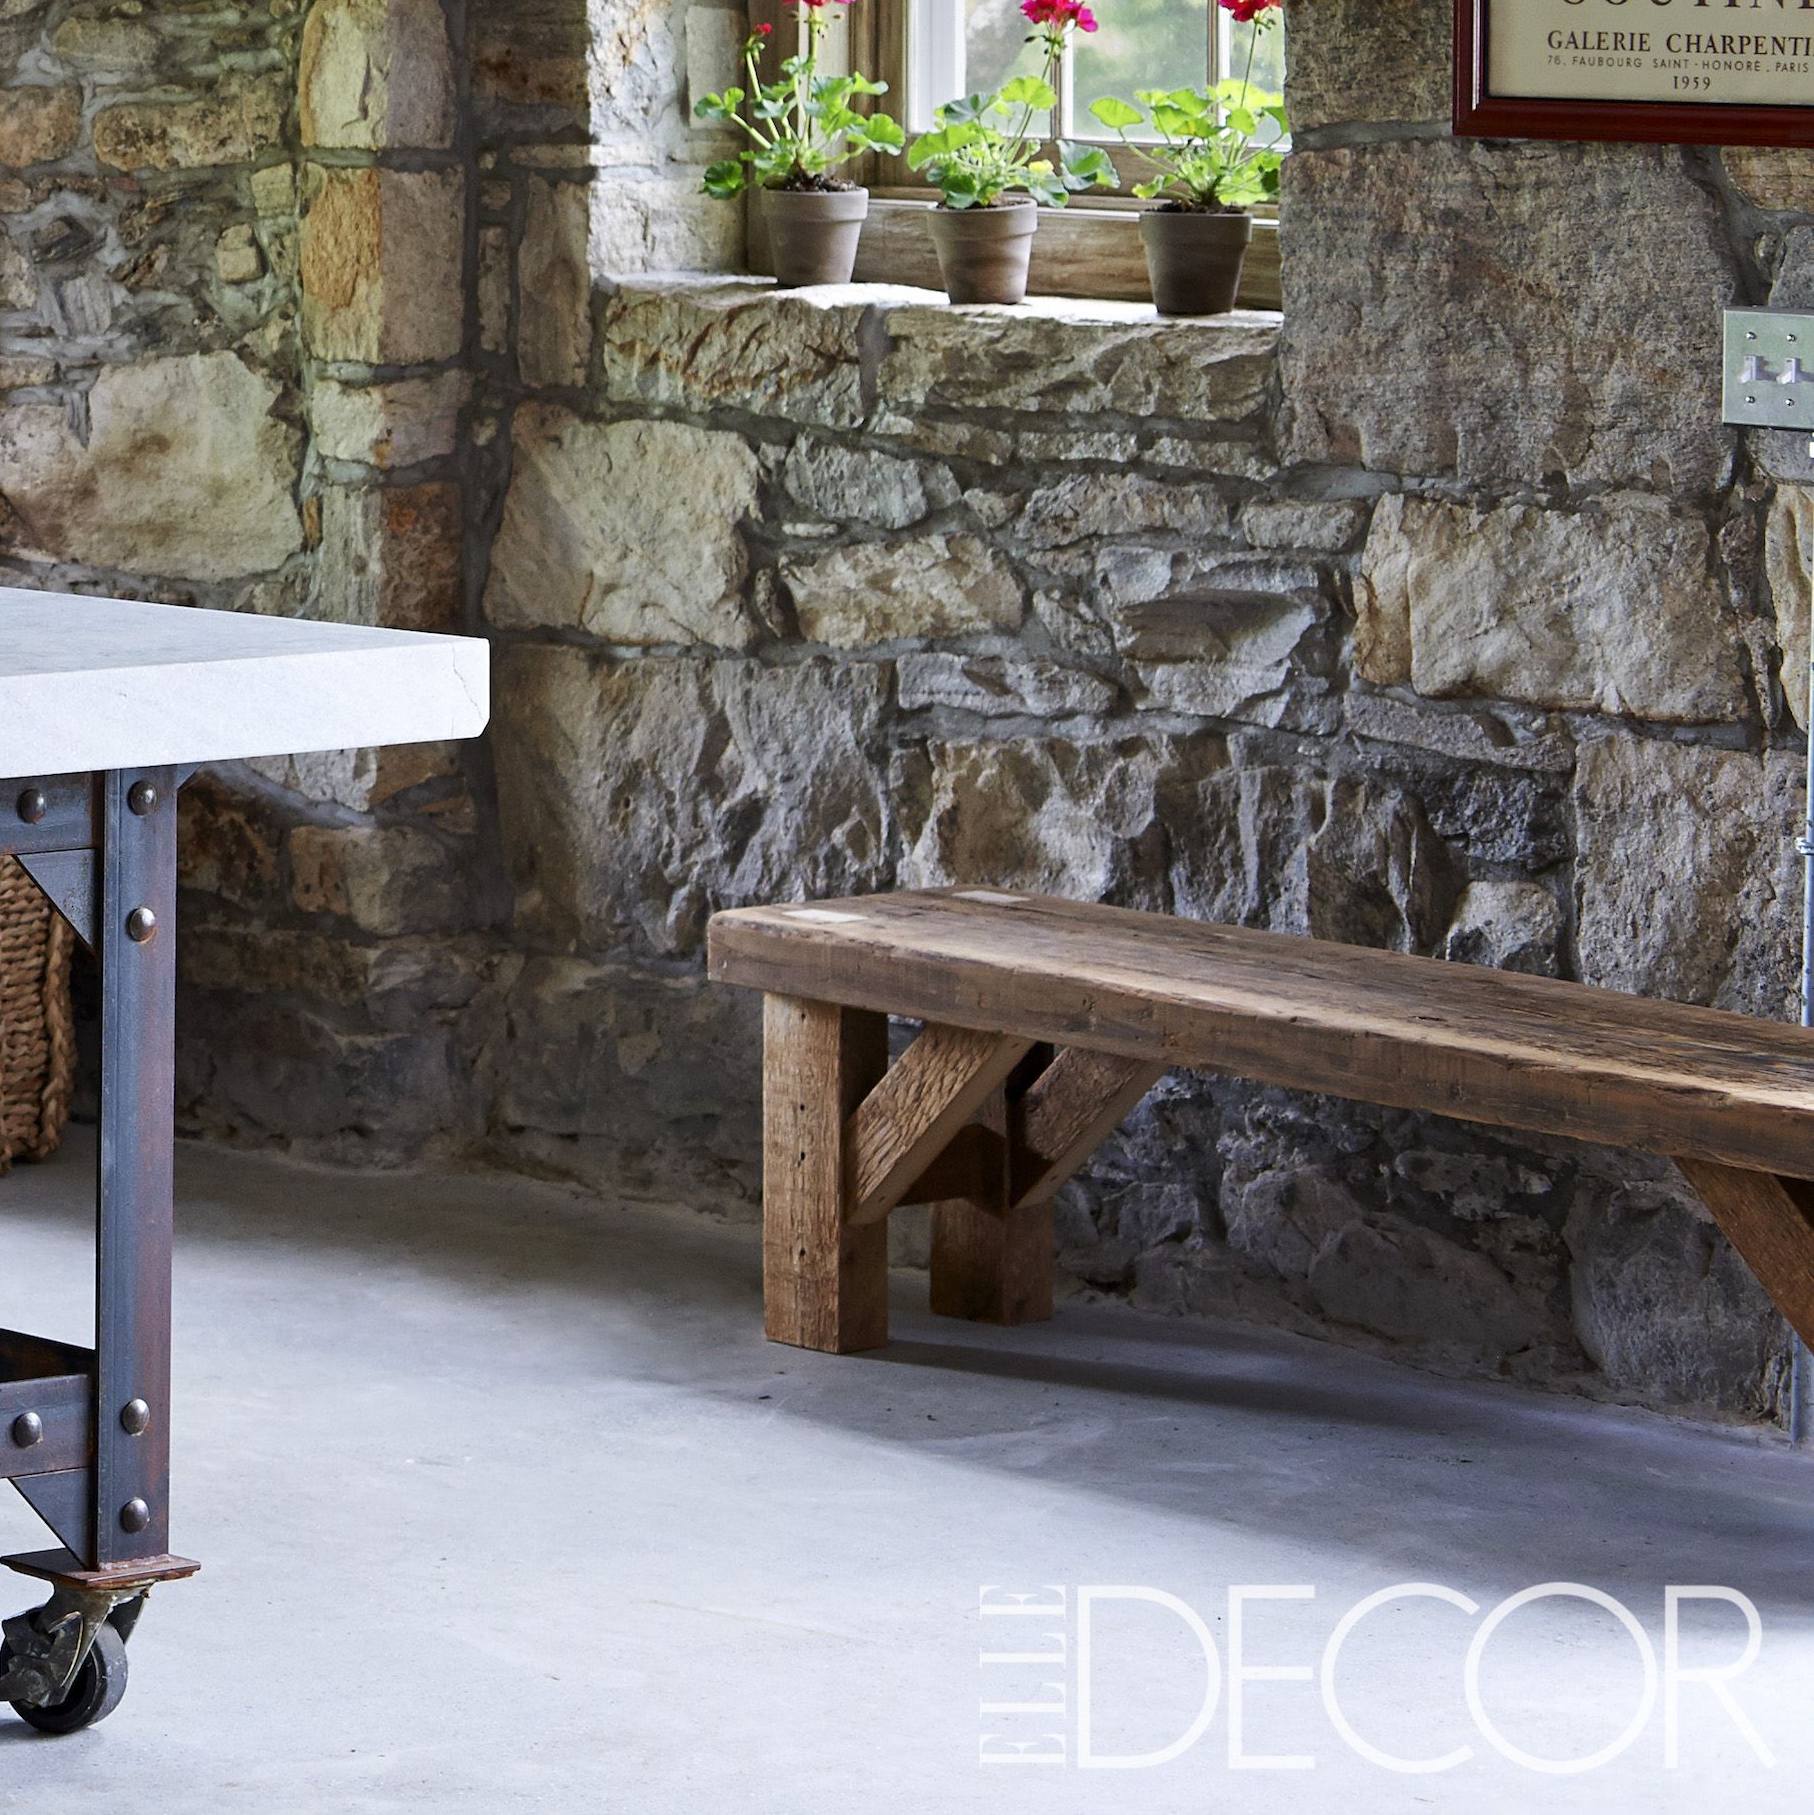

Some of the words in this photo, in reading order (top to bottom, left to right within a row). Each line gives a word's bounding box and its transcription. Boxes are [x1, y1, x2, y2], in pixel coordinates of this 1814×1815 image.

[1548, 30, 1651, 52] GALERIE
[1666, 33, 1814, 56] CHARPENTI
[1572, 56, 1642, 68] FAUBOURG
[1775, 61, 1809, 73] PARIS
[1673, 76, 1711, 90] 1959
